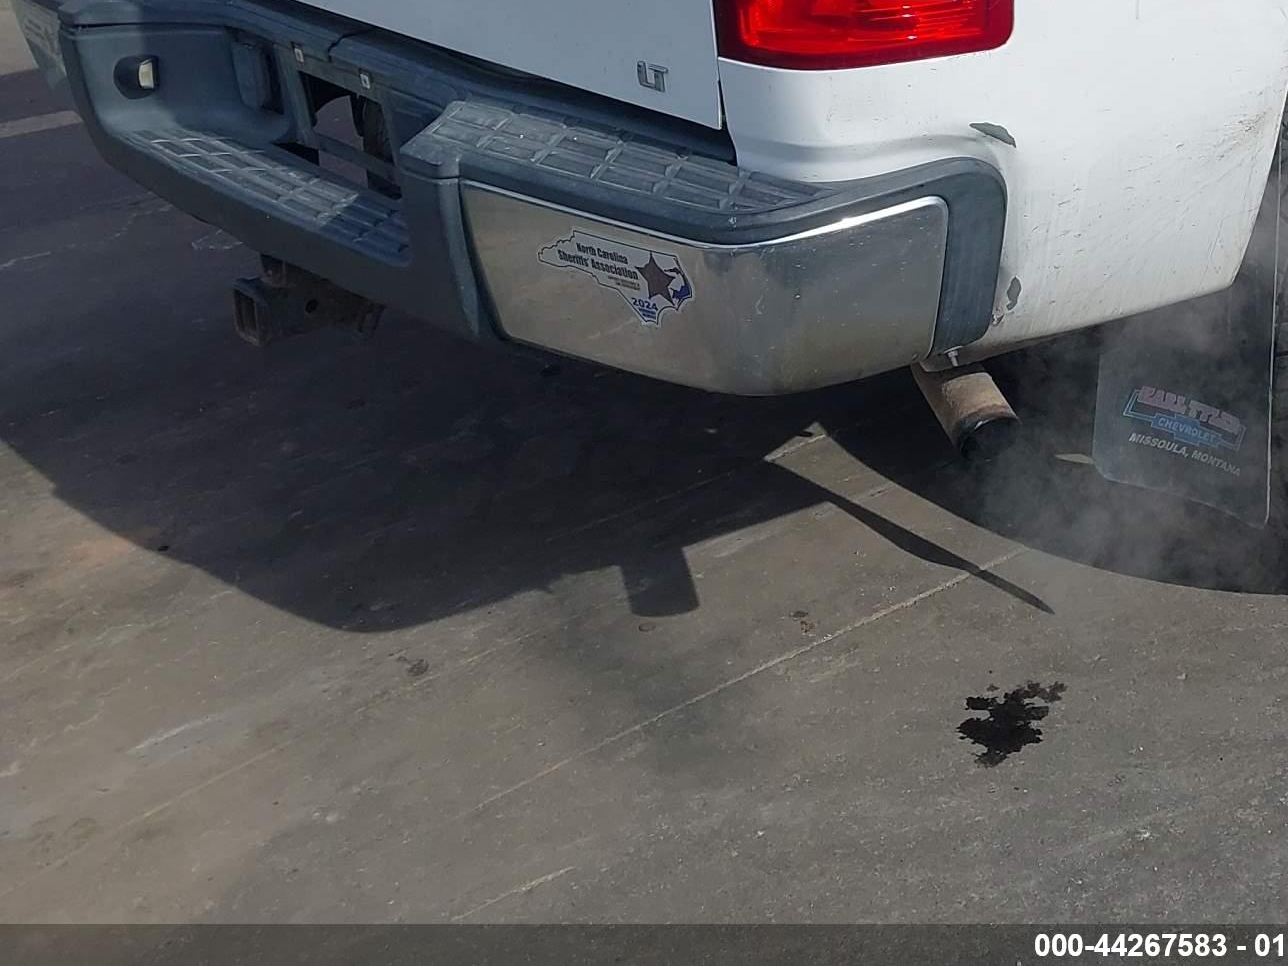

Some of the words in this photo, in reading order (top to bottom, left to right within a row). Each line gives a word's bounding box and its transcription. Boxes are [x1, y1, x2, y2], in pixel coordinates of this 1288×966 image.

[637, 60, 668, 92] LT
[575, 242, 597, 257] North
[597, 247, 628, 265] Carolina
[591, 258, 638, 280] Association
[631, 297, 658, 311] 2024
[1157, 417, 1218, 445] CHEVROLET
[1128, 432, 1189, 458] MISSOULA,
[1191, 449, 1241, 477] MONTANA
